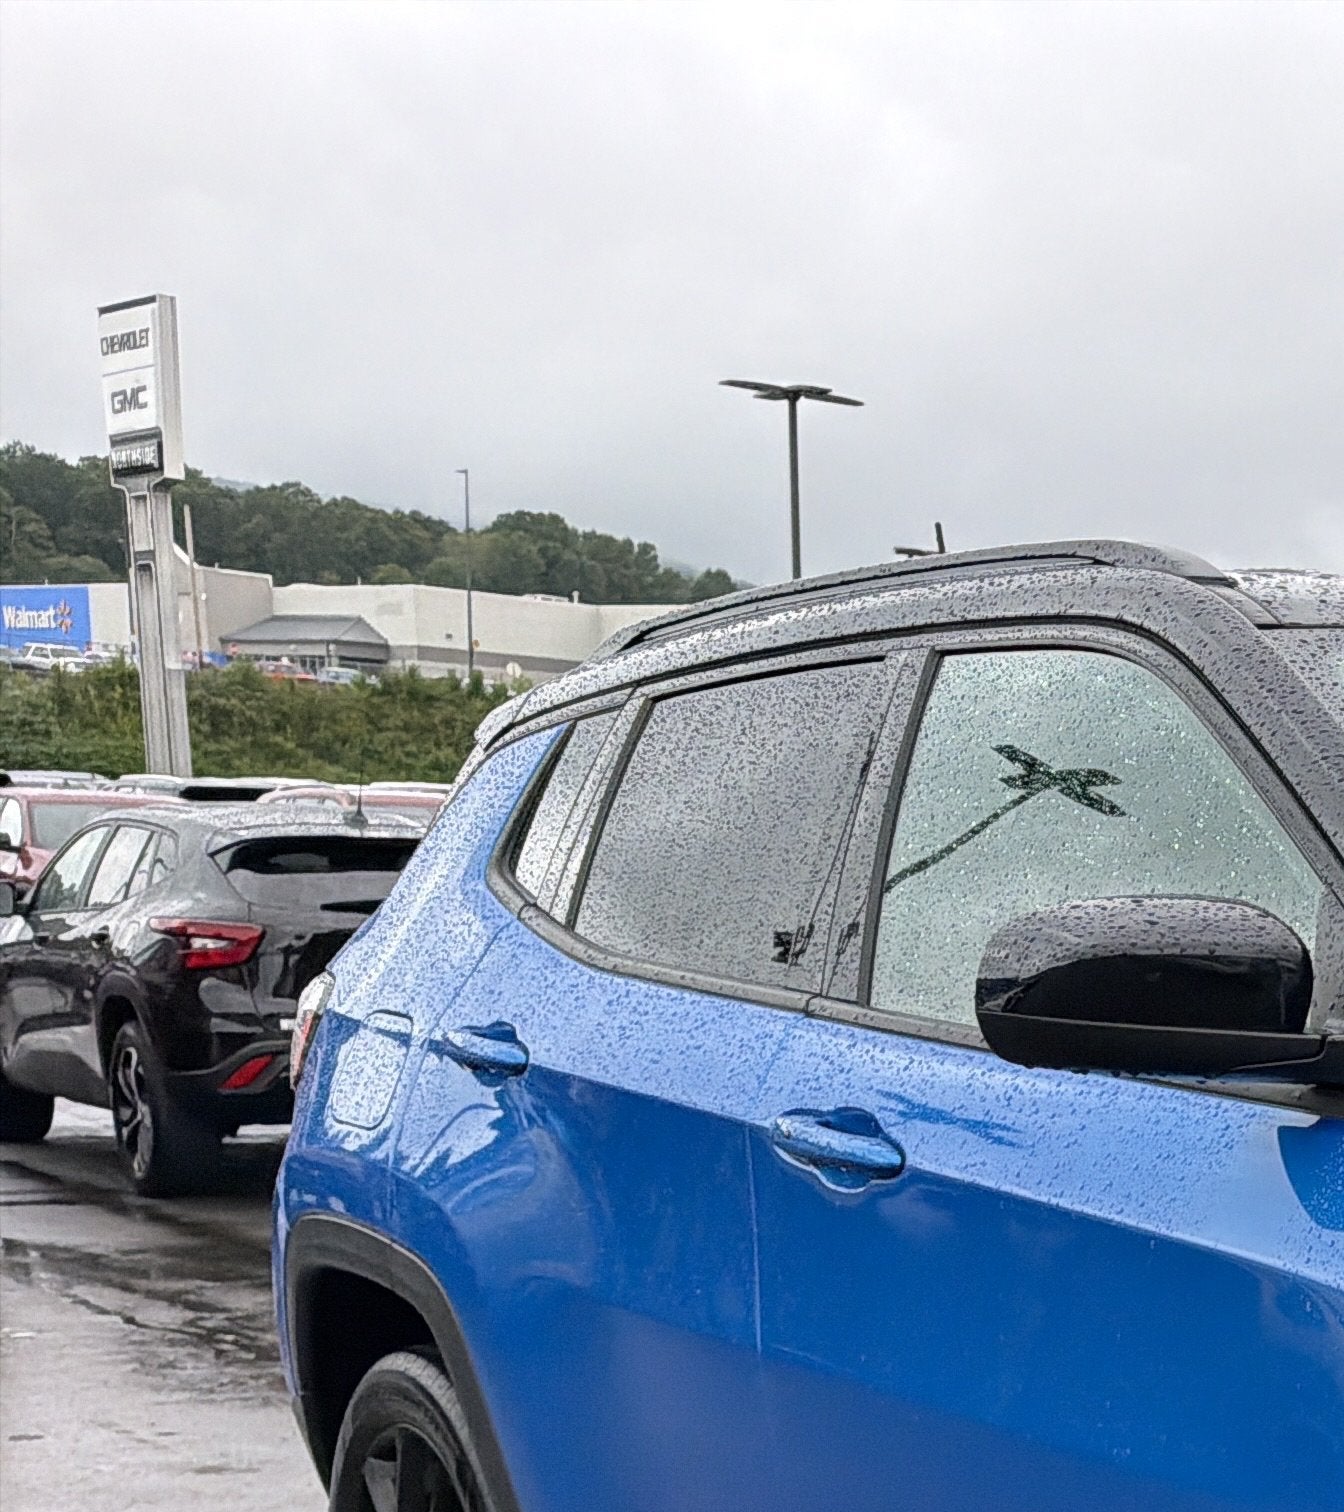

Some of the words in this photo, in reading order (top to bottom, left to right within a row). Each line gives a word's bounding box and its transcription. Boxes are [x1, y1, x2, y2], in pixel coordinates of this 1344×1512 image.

[100, 327, 149, 356] CHEVROLET
[110, 385, 148, 414] GMC
[2, 605, 56, 629] Walmart
